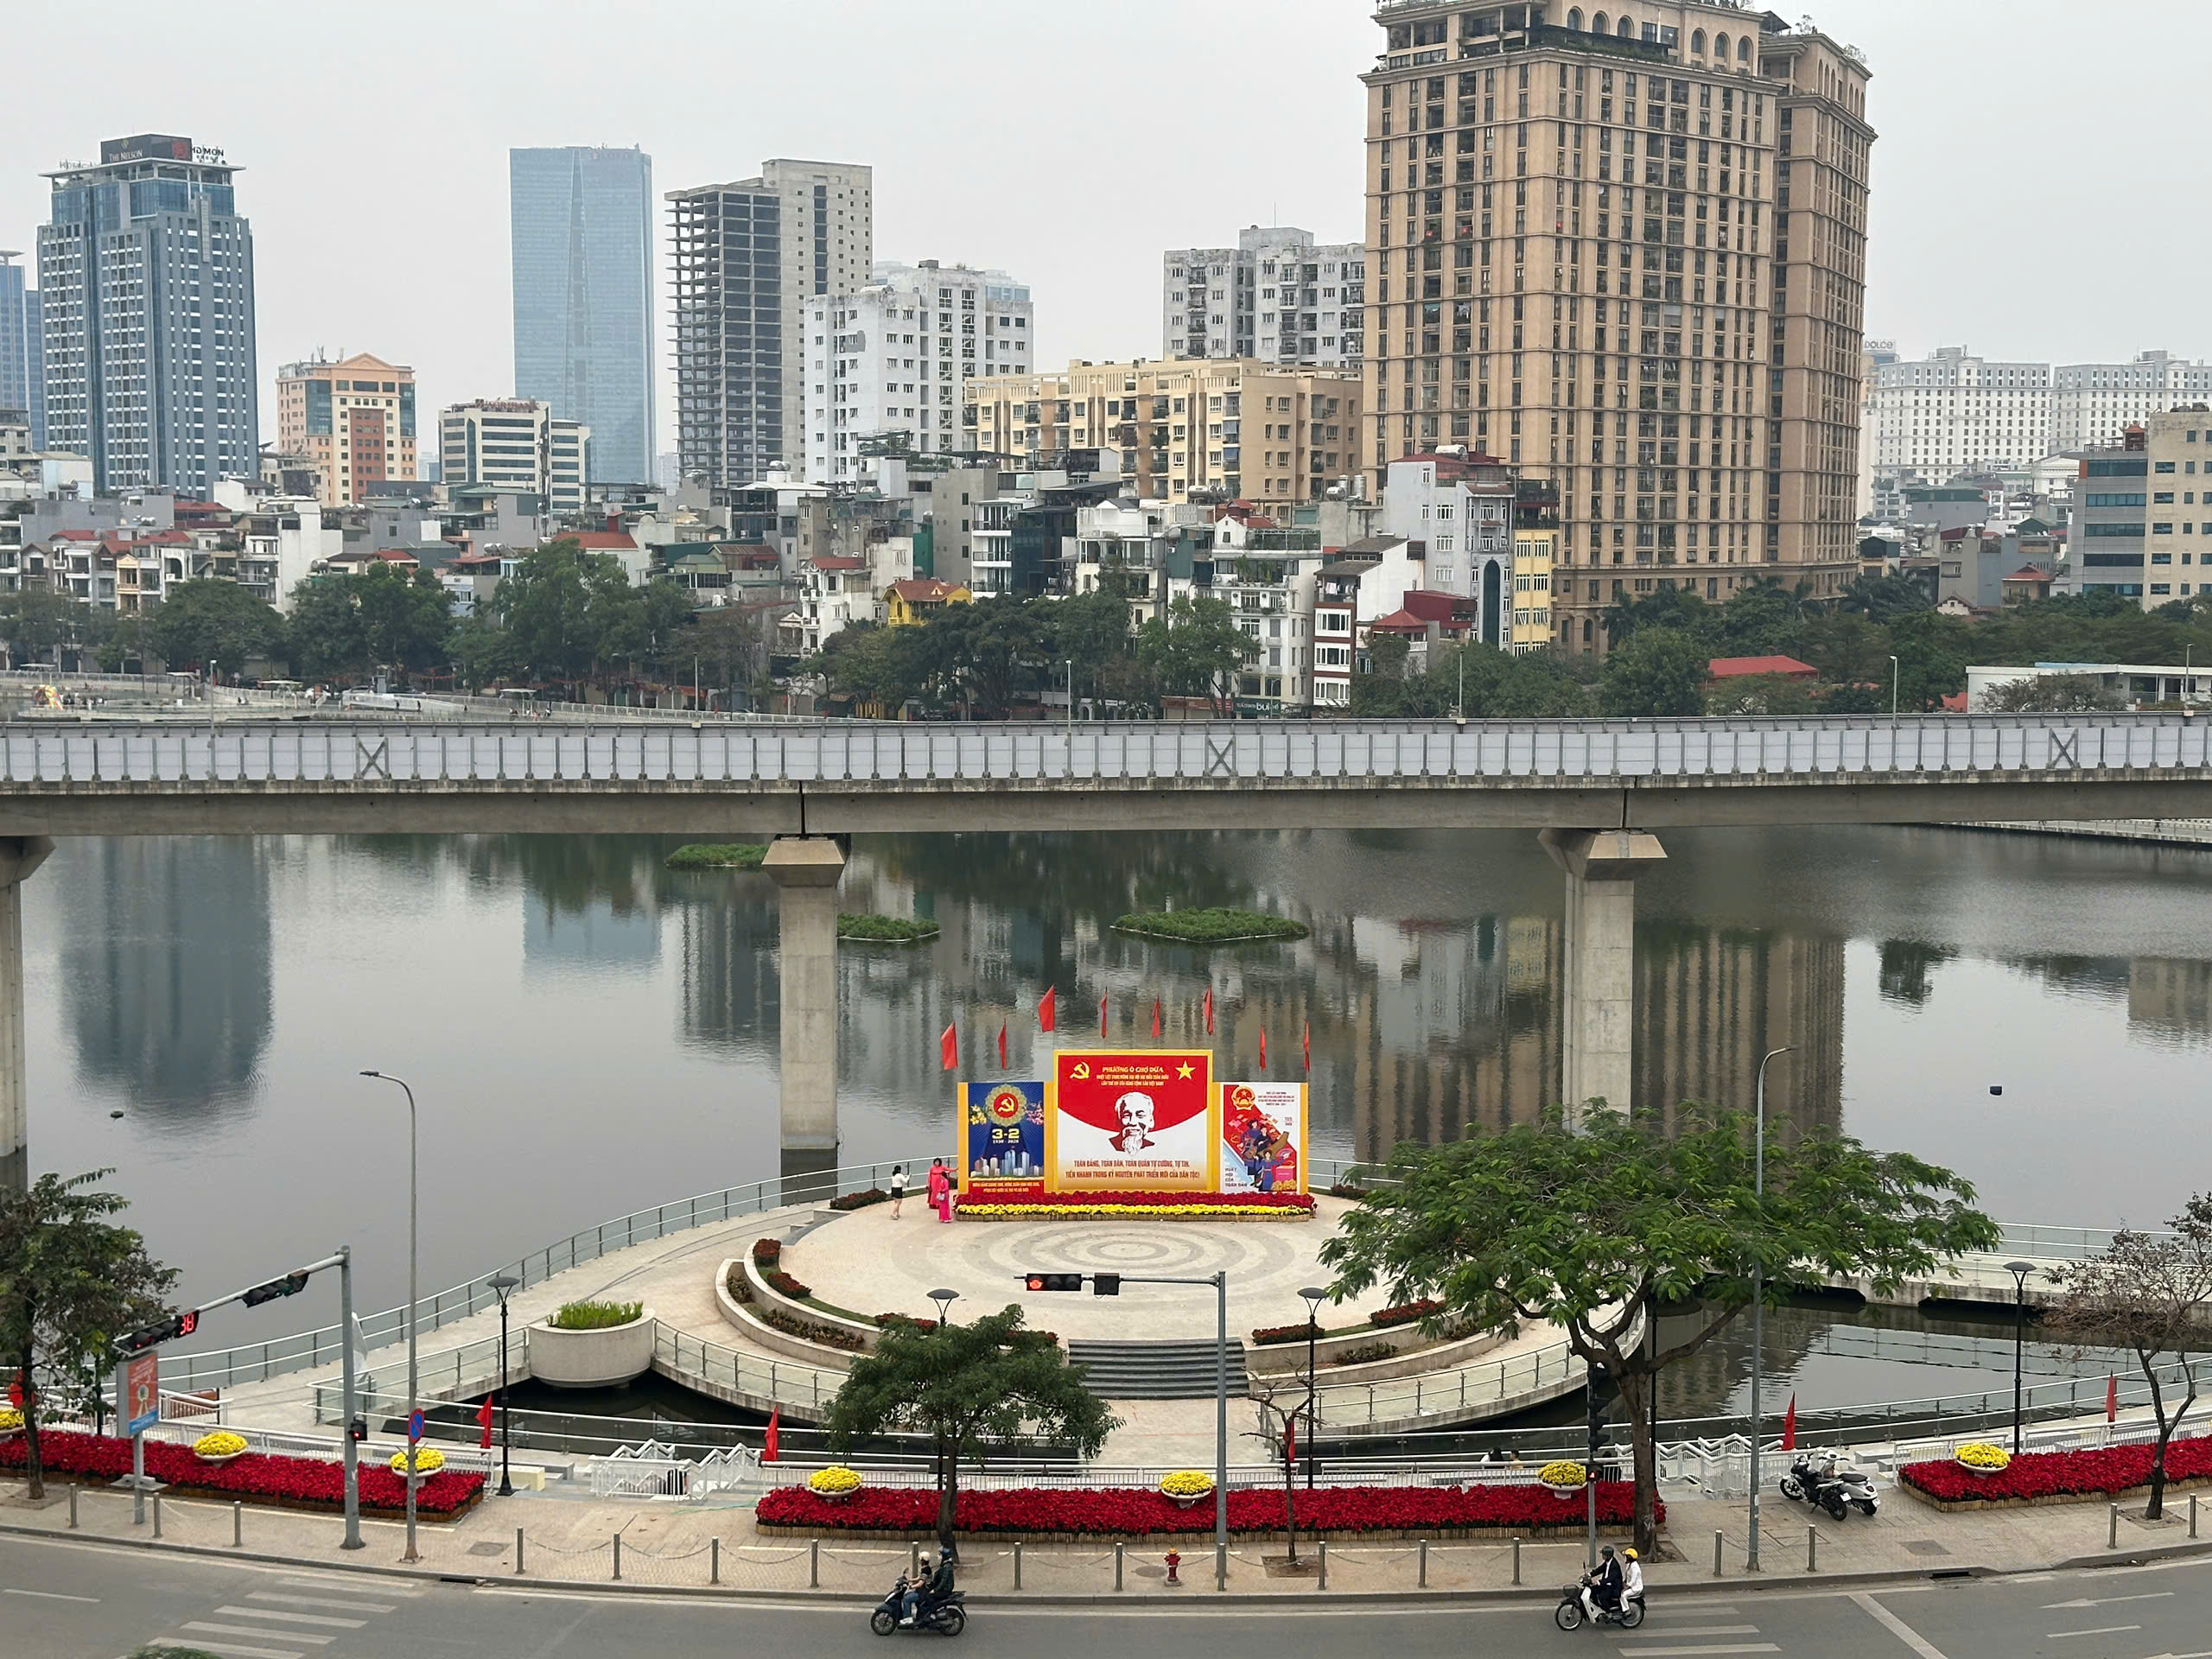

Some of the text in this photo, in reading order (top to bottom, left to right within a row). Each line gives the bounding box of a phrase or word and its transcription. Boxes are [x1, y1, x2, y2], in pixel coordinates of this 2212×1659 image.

[109, 149, 143, 162] THE NELSON
[992, 1128, 1020, 1140] 3-2
[179, 1313, 194, 1336] 38
